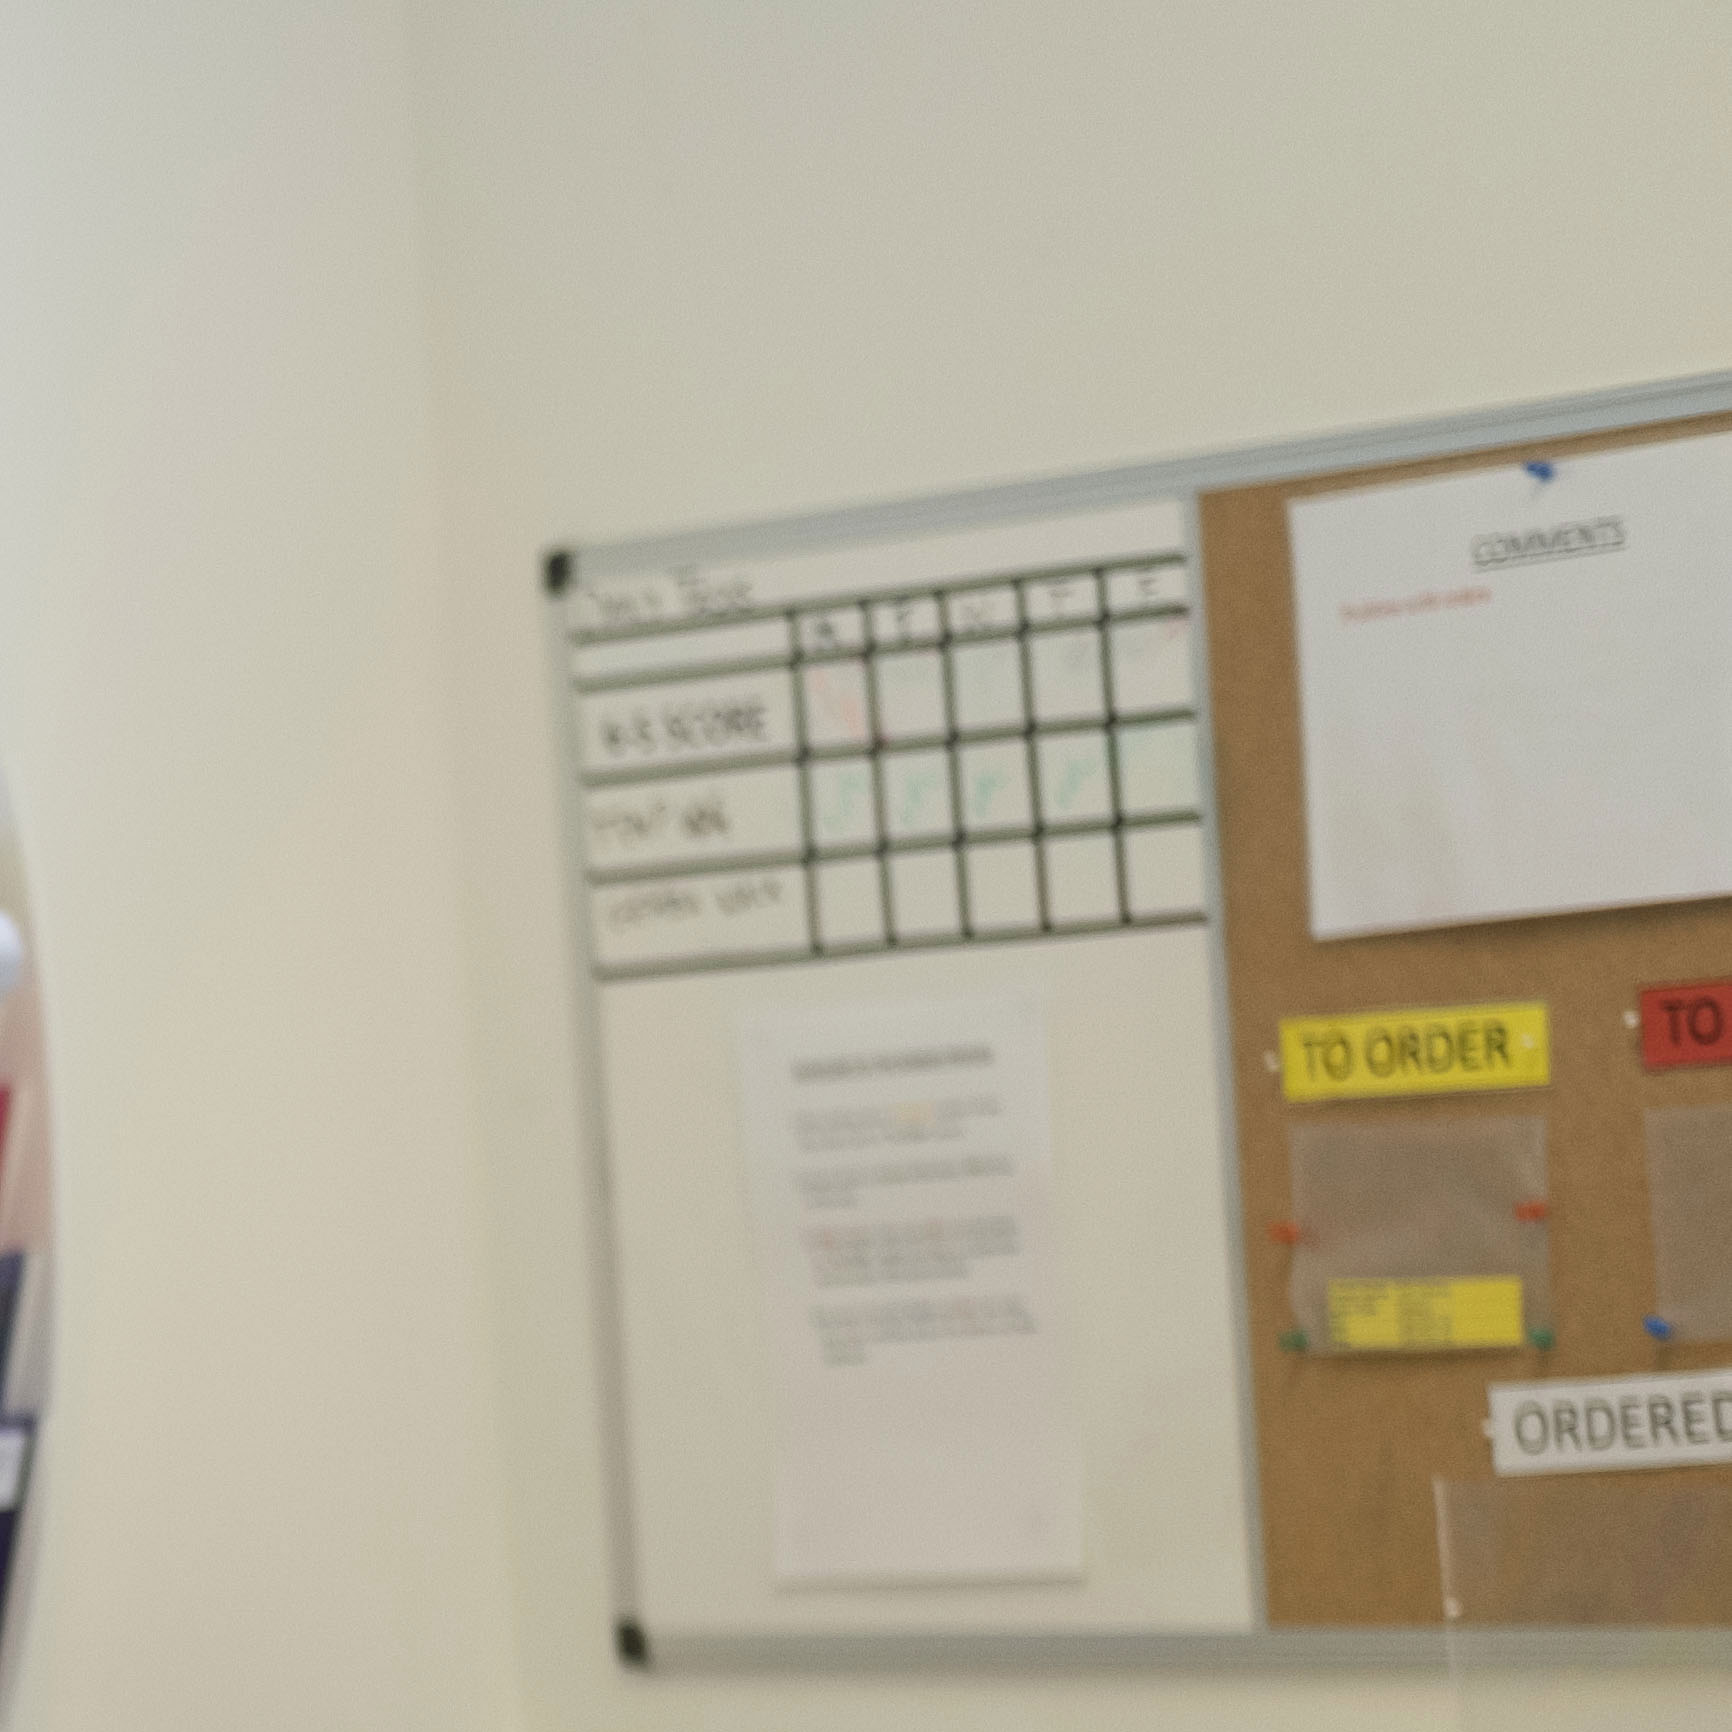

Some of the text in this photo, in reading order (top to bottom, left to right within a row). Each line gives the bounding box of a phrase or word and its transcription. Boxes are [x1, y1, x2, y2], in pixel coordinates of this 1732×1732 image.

[1470, 514, 1628, 565] COMMENTS
[1300, 1017, 1513, 1084] TO ORDER
[1660, 996, 1724, 1048] TO
[1513, 1389, 1732, 1458] ORDERED
